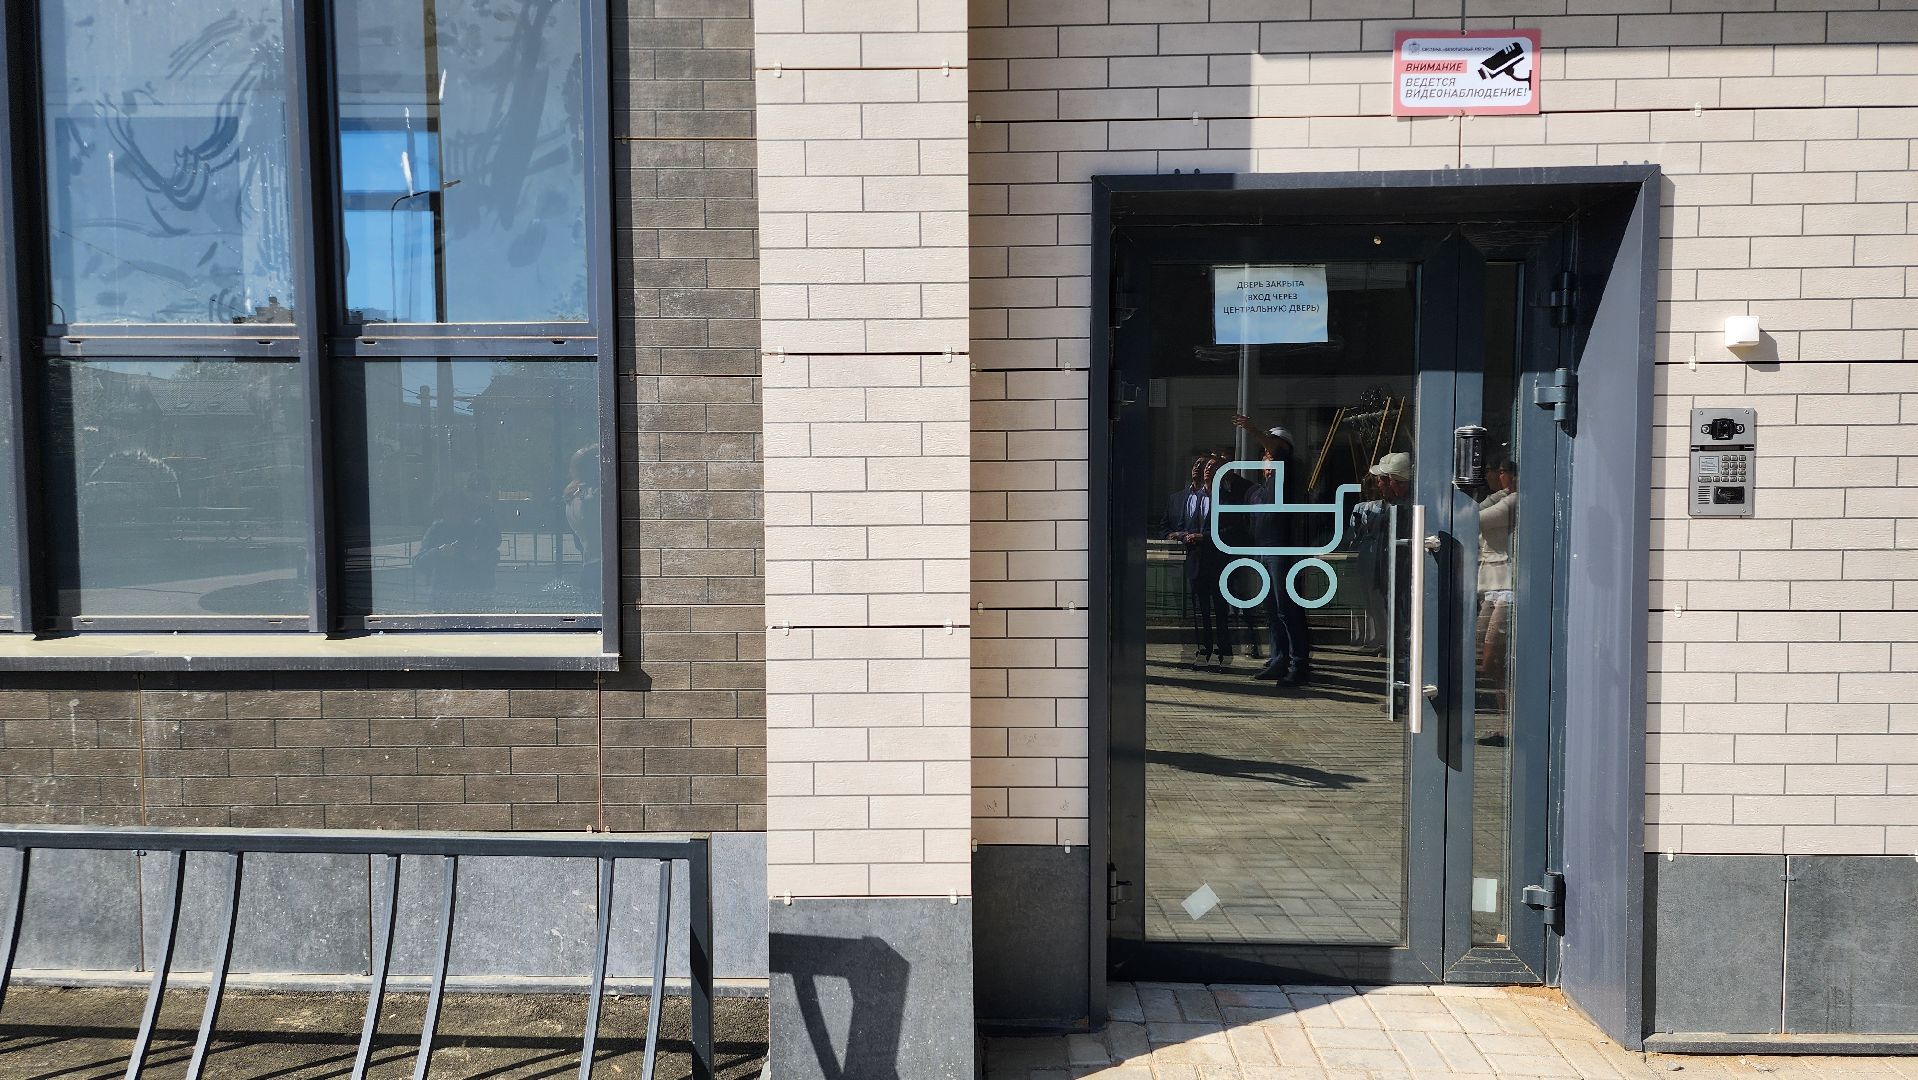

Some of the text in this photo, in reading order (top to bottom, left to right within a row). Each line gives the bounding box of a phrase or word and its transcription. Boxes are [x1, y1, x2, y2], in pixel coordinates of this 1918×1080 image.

[1405, 62, 1463, 72] ВНИМАНИЕ
[1405, 77, 1456, 88] ВЕДЕТСЯ
[1405, 87, 1527, 99] ВИДЕОНАБЛЮДЕНИЕ!
[1237, 280, 1305, 290] ДВЕРЬ ЗАКРЫТА
[1223, 304, 1320, 315] ЦЕНТРАЛЬНУЮ ДВЕРЬ)
